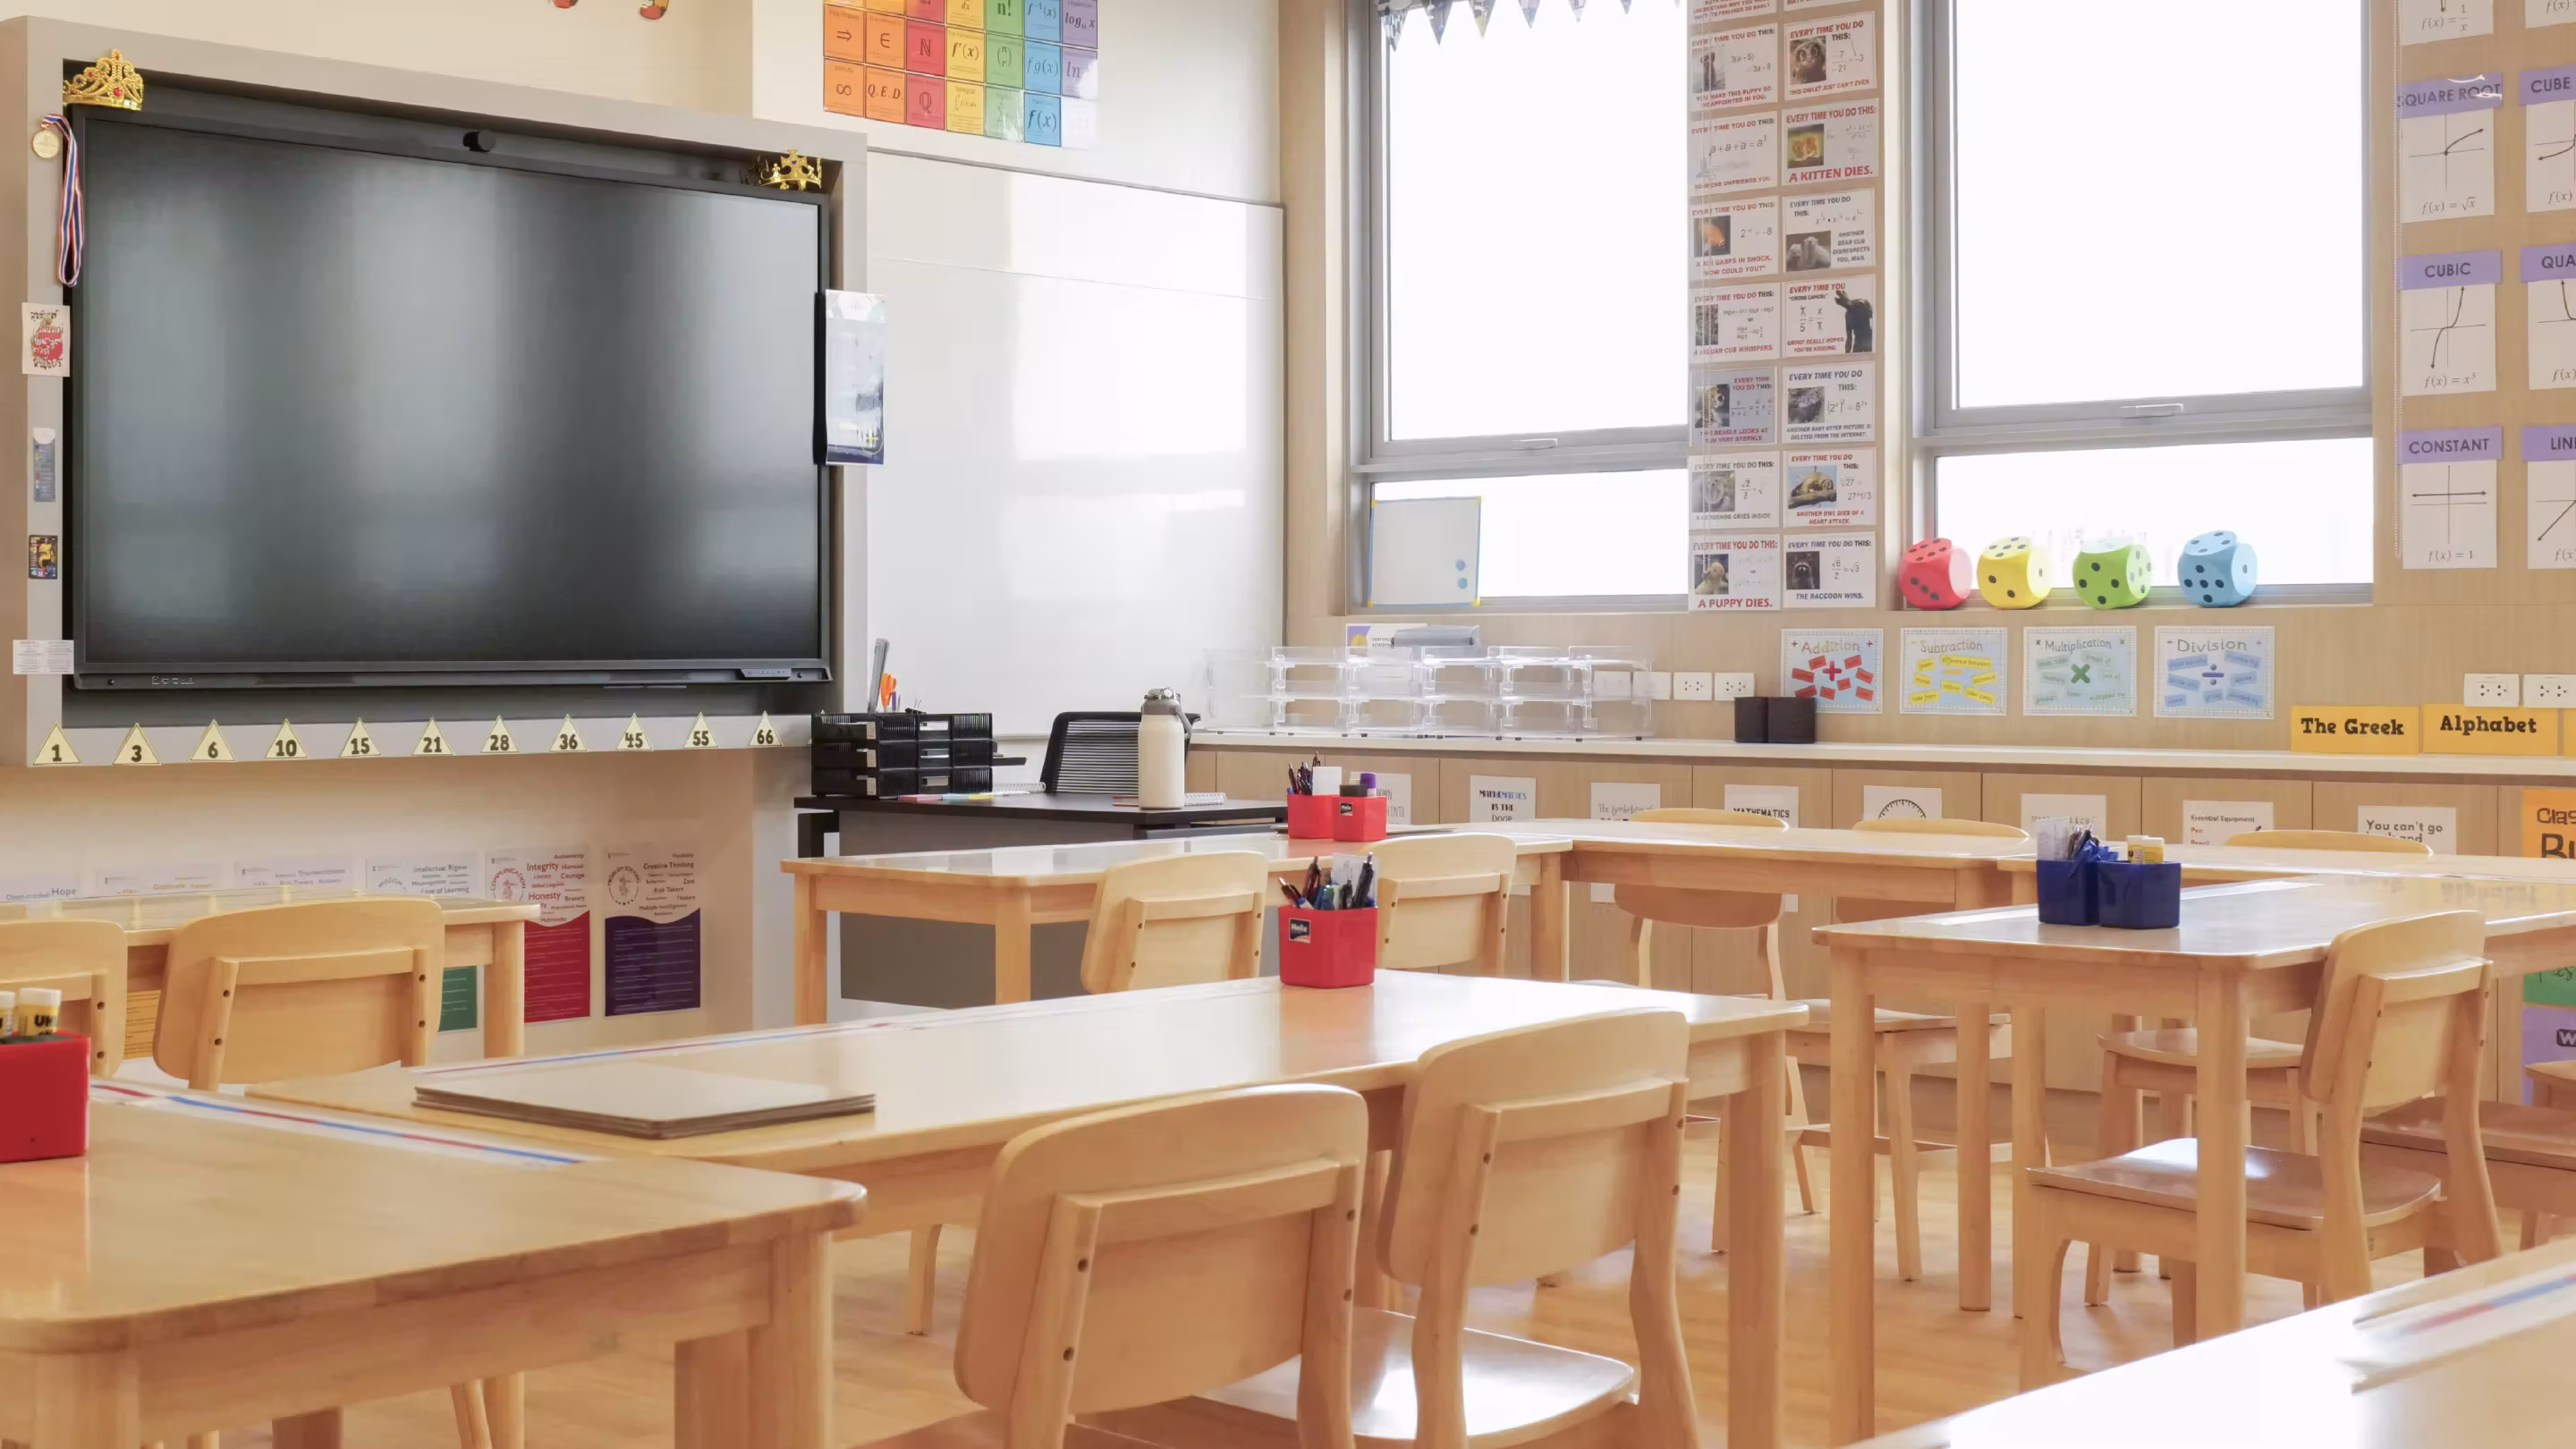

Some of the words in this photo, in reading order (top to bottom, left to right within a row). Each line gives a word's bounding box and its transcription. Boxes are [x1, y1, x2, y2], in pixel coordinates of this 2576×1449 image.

[1731, 32, 1745, 40] YOU
[1747, 30, 1756, 38] DO
[1790, 29, 1814, 38] EVERY
[1817, 25, 1834, 34] TIME
[1835, 22, 1851, 30] YOU
[1853, 20, 1864, 28] DO
[1832, 33, 1851, 41] THIS:
[2530, 77, 2571, 93] CUBE
[2397, 89, 2454, 107] SQUARE
[2459, 84, 2500, 100] ROOT
[1787, 112, 1809, 123] EVERY
[1810, 110, 1827, 121] TIME
[1829, 109, 1844, 119] YOU
[1845, 107, 1856, 116] DO
[1858, 106, 1876, 115] THIS:
[1789, 172, 1798, 182] A
[1801, 168, 1842, 182] KITTEN
[1844, 165, 1873, 177] DIES.
[1748, 202, 1757, 210] DO
[1790, 200, 1809, 208] EVERY
[1827, 197, 1841, 205] YOU
[1793, 209, 1809, 217] THIS:
[2425, 263, 2471, 278] CUBIC
[1758, 290, 1775, 298] THIS:
[1790, 285, 1811, 293] EVERY
[1831, 283, 1845, 291] YOU
[1789, 372, 1812, 381] EVERY
[1814, 371, 1832, 379] TIME
[1834, 370, 1850, 378] YOU
[1852, 369, 1862, 377] DO
[1838, 383, 1857, 391] THIS:
[2409, 438, 2489, 454] CONSTANT
[1792, 454, 1812, 462] EVERY
[1813, 453, 1827, 462] TIME
[1693, 542, 1715, 550] EVERY
[1716, 541, 1731, 550] TIME
[1733, 541, 1748, 549] YOU
[1749, 540, 1759, 549] DO
[1761, 540, 1777, 548] THIS:
[1698, 599, 1706, 608] A
[1708, 598, 1742, 608] PUPPY
[1746, 598, 1773, 607] DIES.
[1801, 640, 1860, 655] Addition
[1919, 640, 1983, 654] Subtraction
[2045, 639, 2112, 655] Multiplication
[2177, 639, 2248, 653] Division
[2301, 717, 2337, 734] The
[2344, 718, 2404, 735] Greek
[2440, 716, 2537, 736] Alphabet
[490, 734, 509, 751] 28
[560, 733, 578, 750] 36
[625, 733, 643, 748] 45
[693, 731, 709, 746] 55
[757, 730, 774, 744] 66
[52, 744, 62, 761] 1
[208, 741, 218, 758] 6
[275, 740, 297, 757] 10
[351, 738, 370, 755] 15
[423, 737, 442, 753] 21
[131, 744, 142, 762] 3
[1479, 789, 1526, 800] MATHEMATICS
[2366, 819, 2390, 831] You
[2394, 821, 2424, 832] can't
[2428, 824, 2443, 835] go
[527, 862, 558, 872] Integrity
[490, 869, 526, 891] COMMUNICATION
[51, 887, 77, 896] Hope
[529, 893, 561, 901] Honesty
[1292, 923, 1307, 933] Helix
